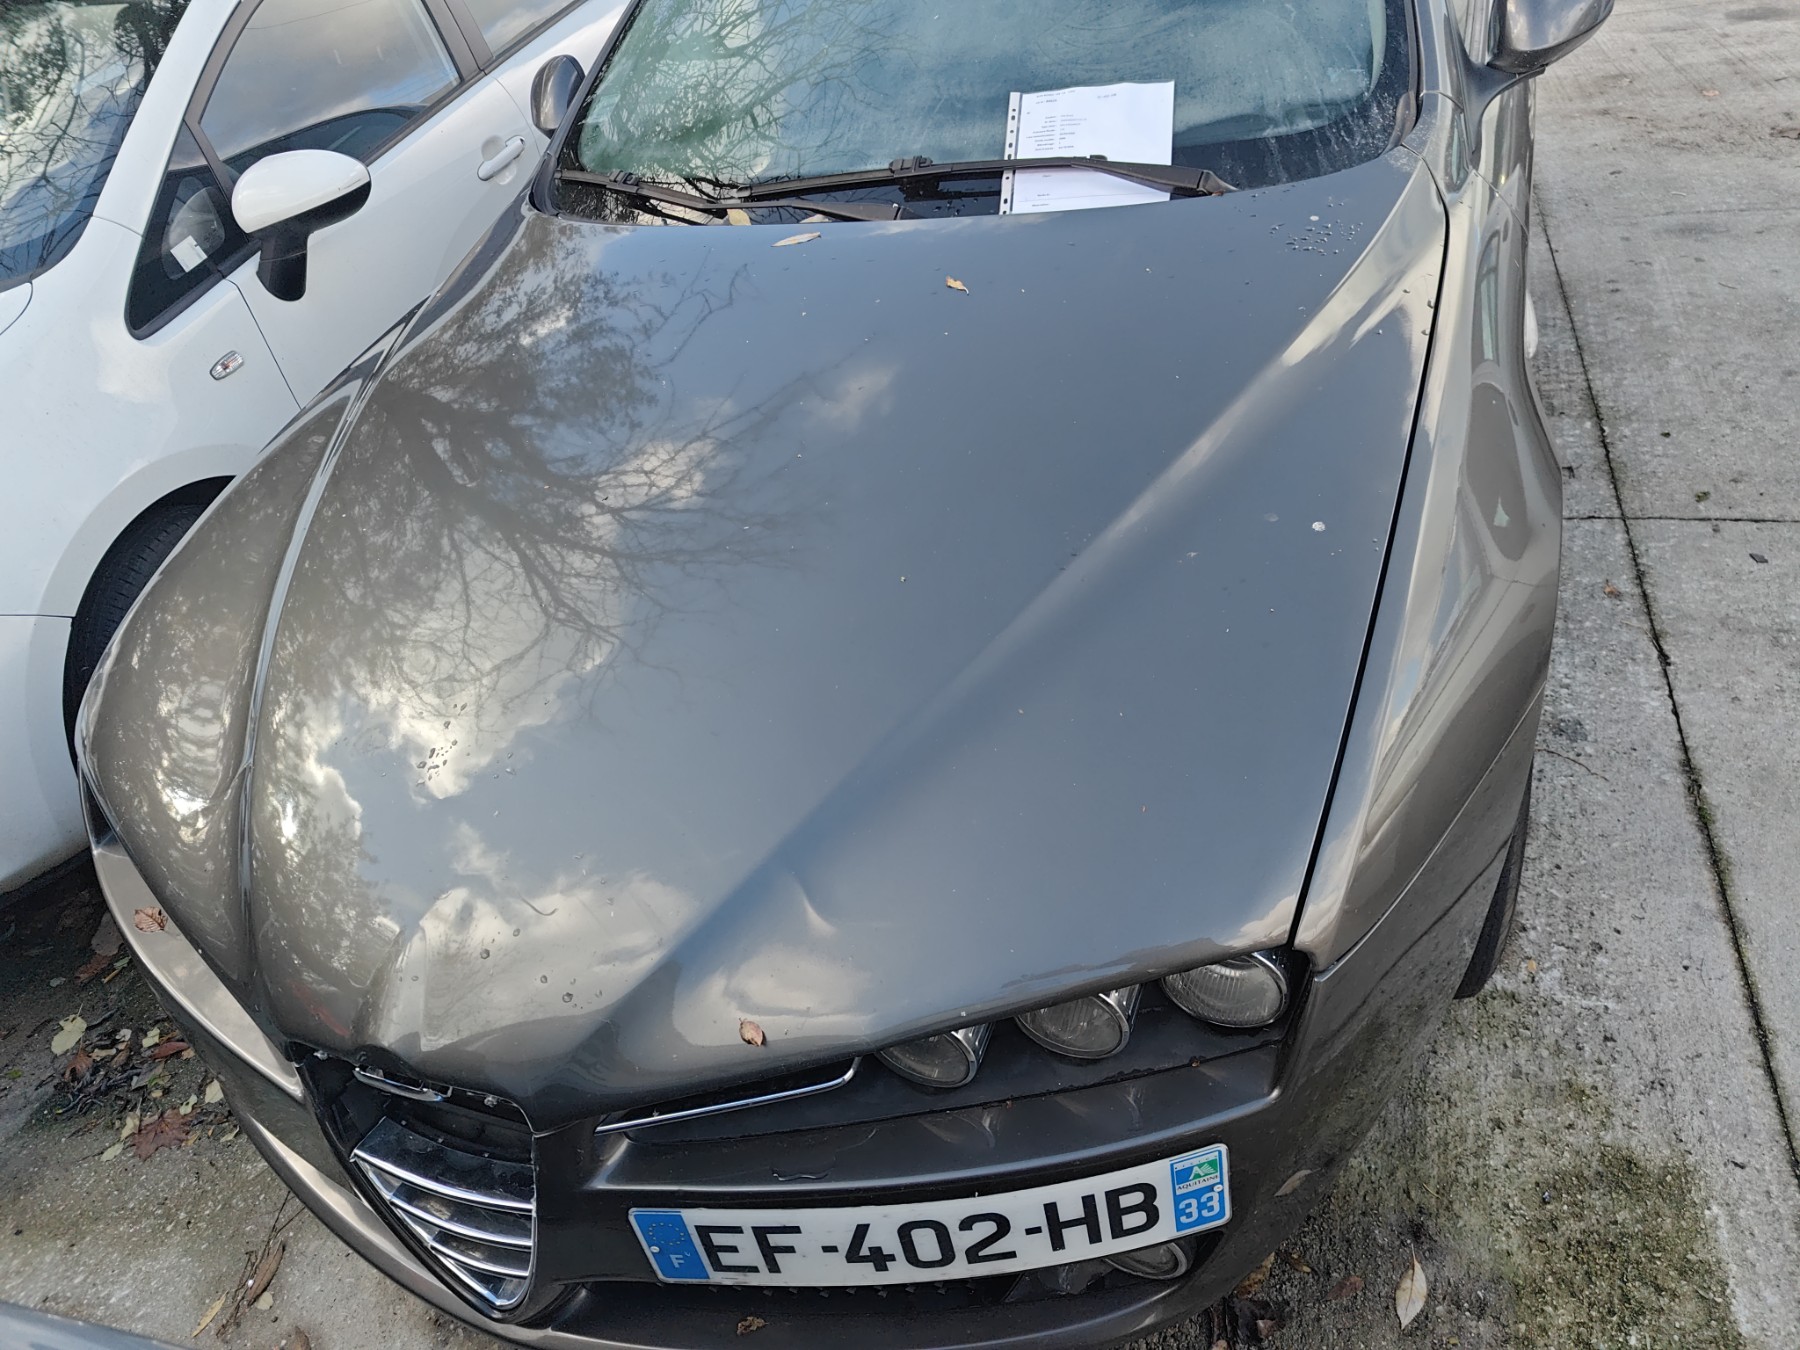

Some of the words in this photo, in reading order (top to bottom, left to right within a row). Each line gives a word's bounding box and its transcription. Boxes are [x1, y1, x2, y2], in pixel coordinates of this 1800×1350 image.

[1177, 1175, 1219, 1191] AQUITAINE
[1179, 1191, 1220, 1224] 33
[670, 1253, 685, 1269] F
